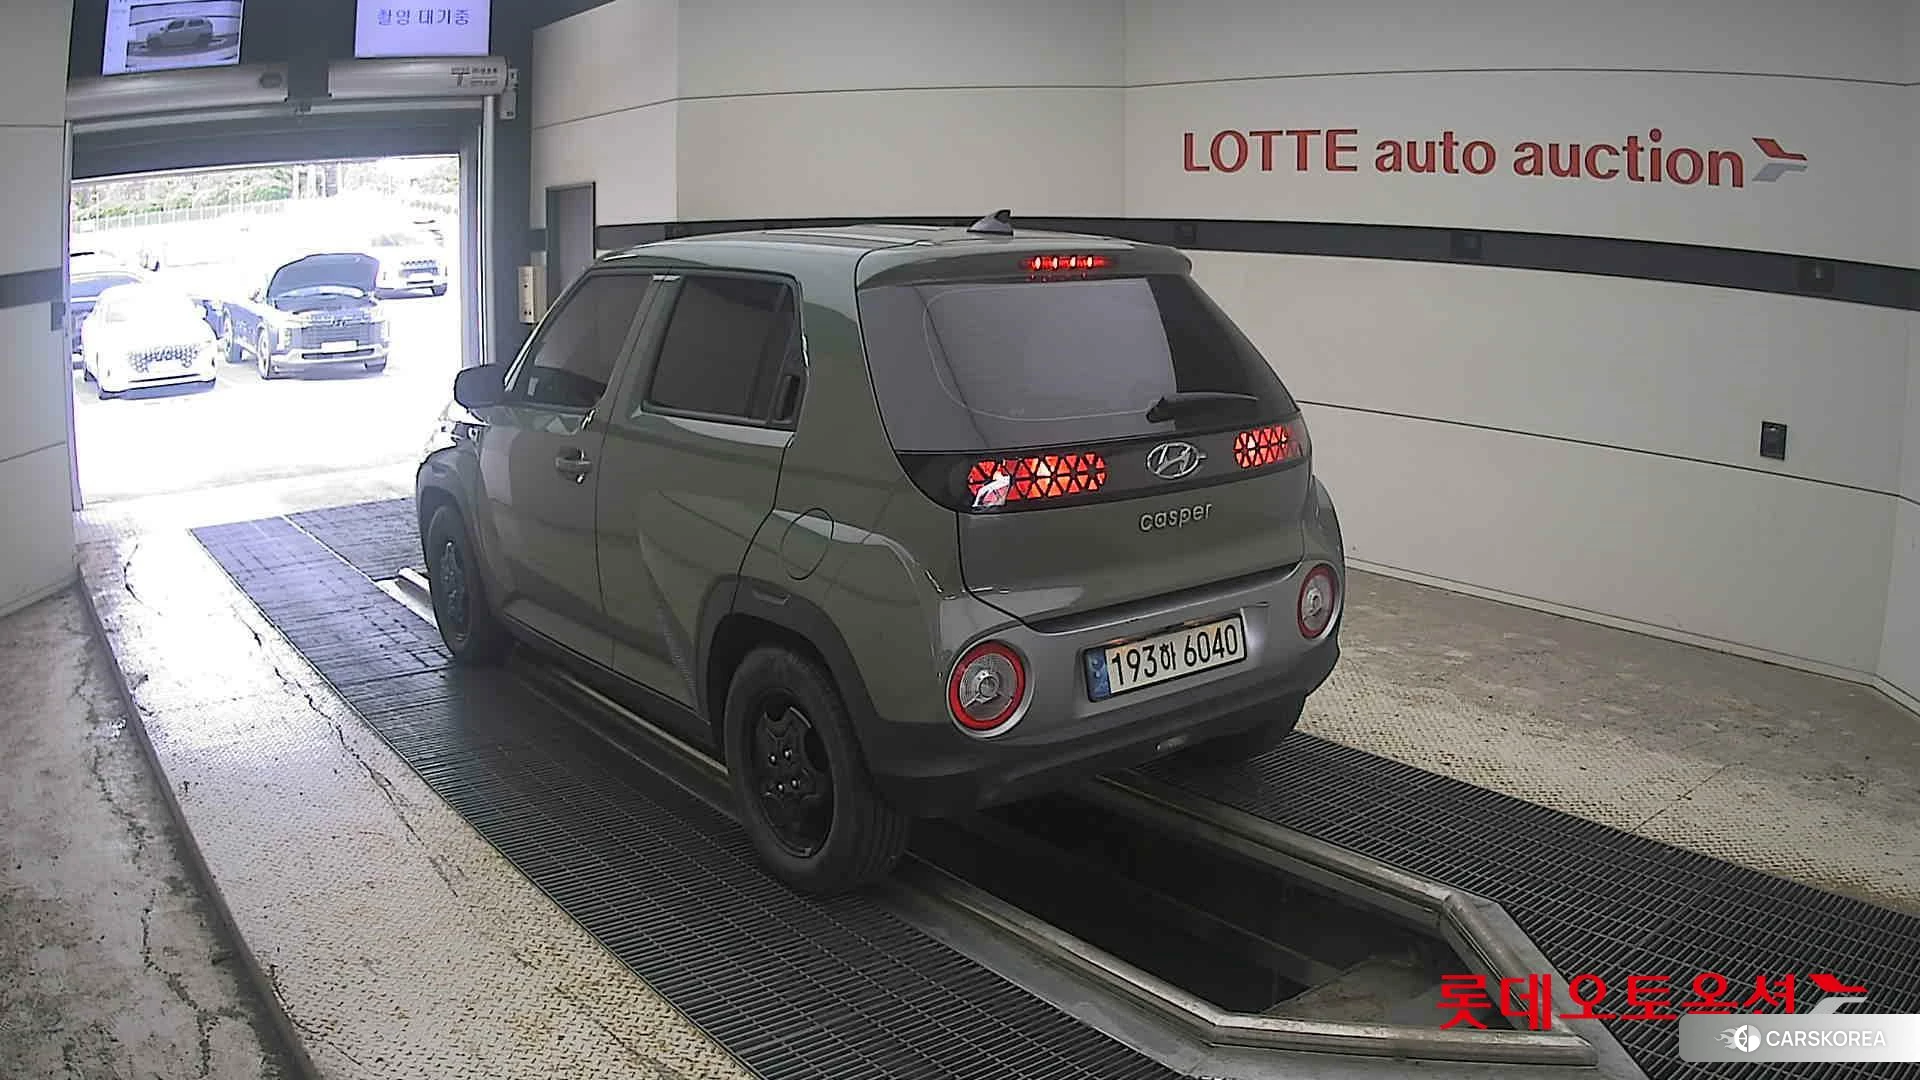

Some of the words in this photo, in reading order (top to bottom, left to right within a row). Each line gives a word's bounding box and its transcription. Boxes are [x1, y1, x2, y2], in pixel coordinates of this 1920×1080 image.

[1183, 129, 1358, 172] LOTTE
[1375, 130, 1496, 175] auto
[1513, 128, 1744, 188] auction
[1139, 503, 1212, 531] casper
[1183, 624, 1238, 667] 6040
